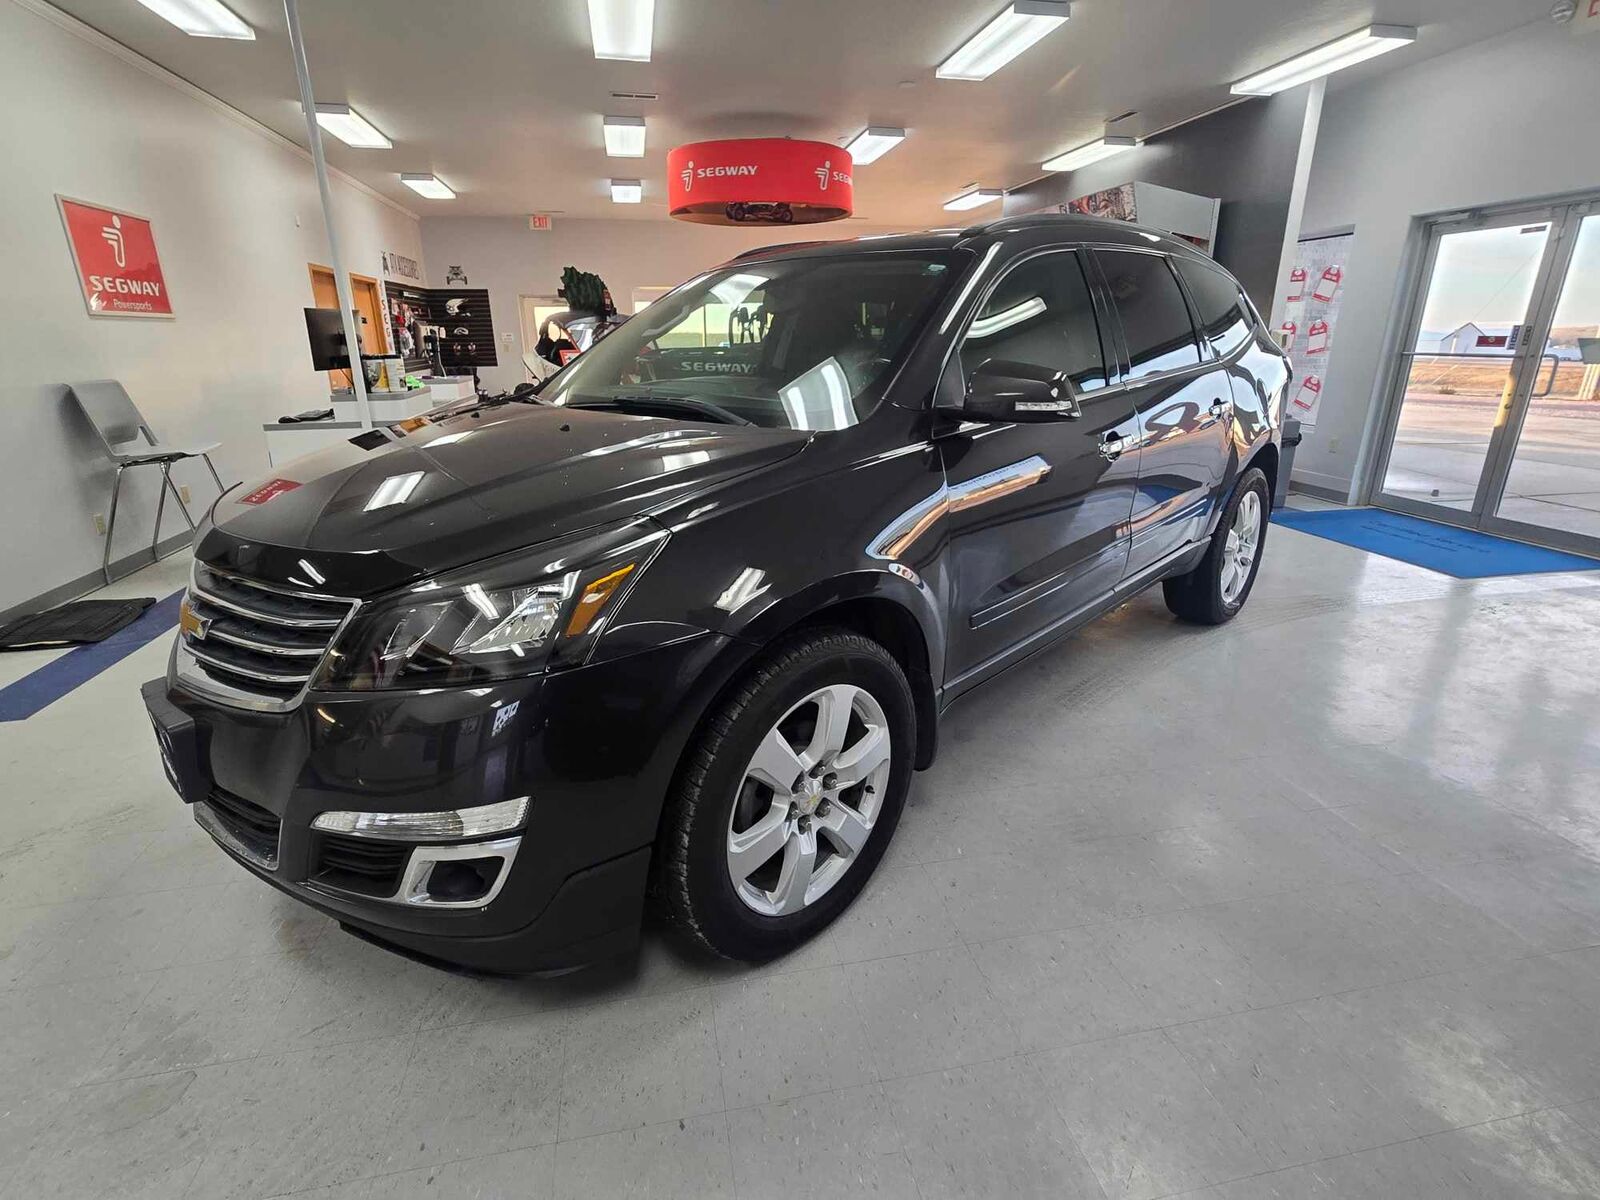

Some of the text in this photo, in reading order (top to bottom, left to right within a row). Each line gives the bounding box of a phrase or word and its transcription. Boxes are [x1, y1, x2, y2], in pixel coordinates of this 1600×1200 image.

[697, 165, 758, 178] SEGWAY
[89, 275, 160, 297] SEGWAY
[113, 299, 152, 311] Powersports
[681, 361, 751, 374] SEGWAY
